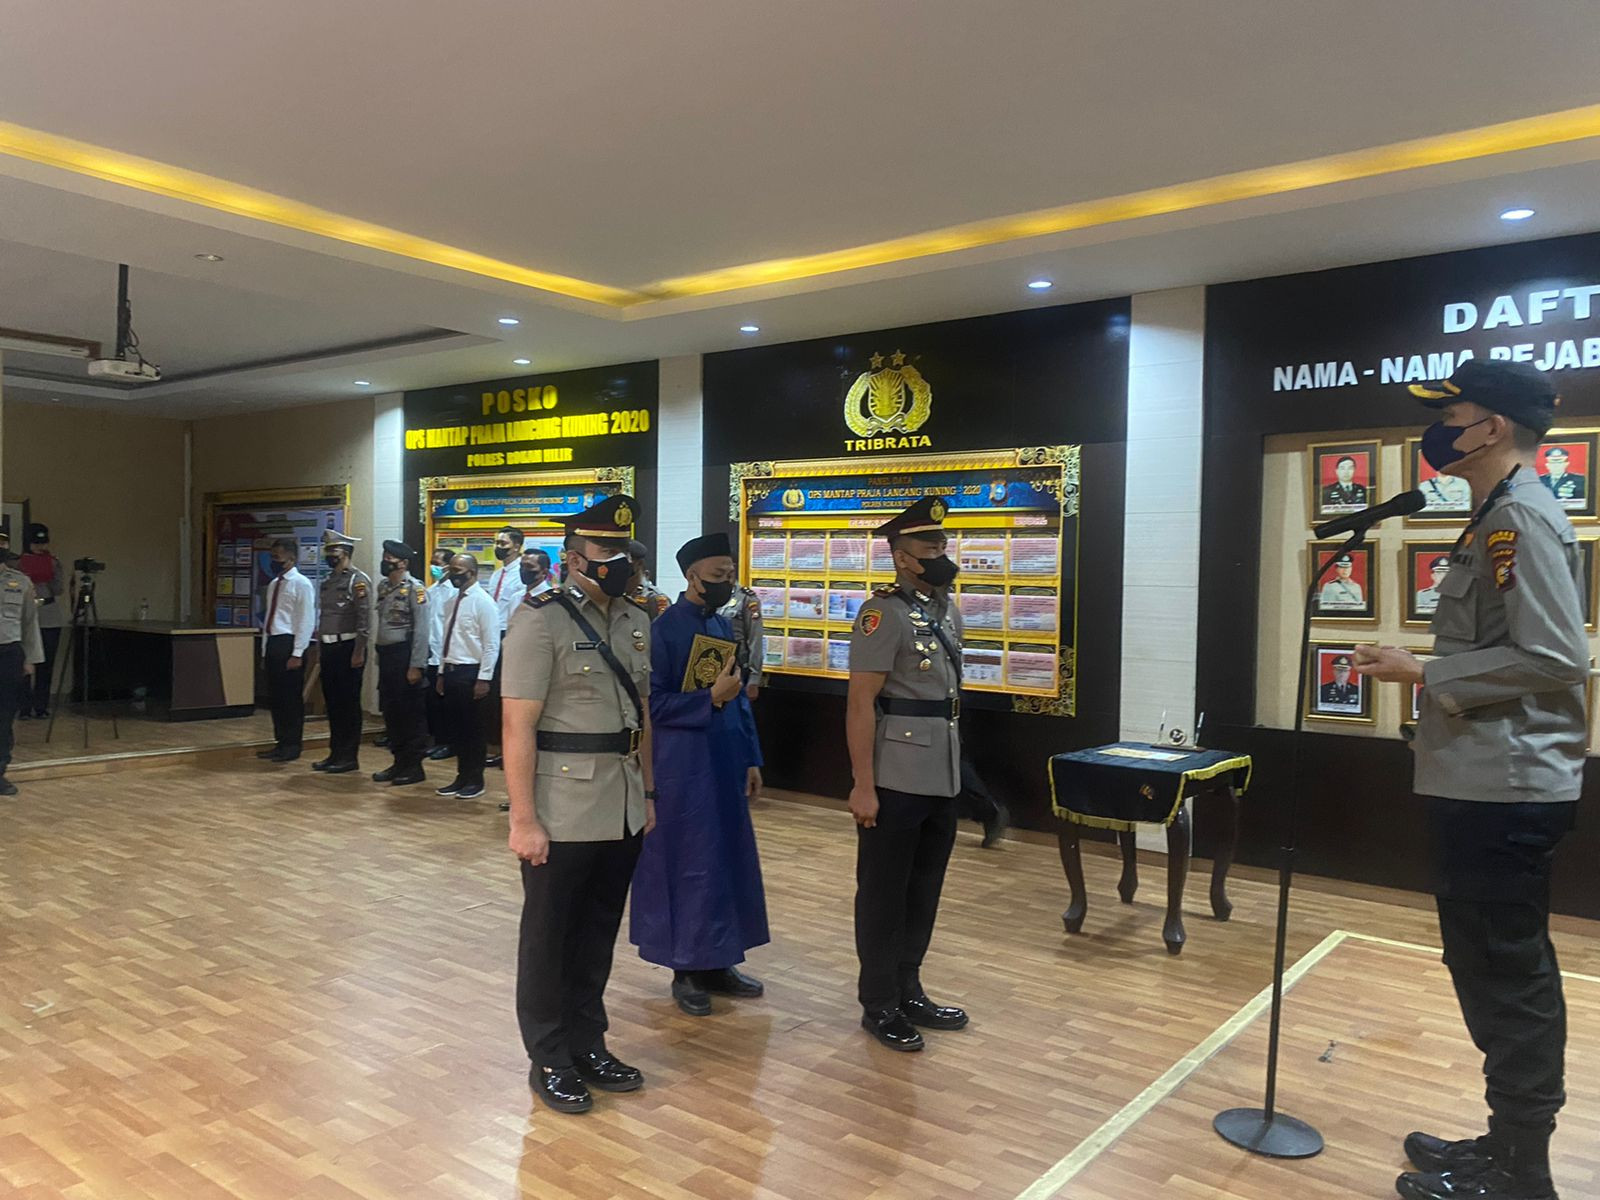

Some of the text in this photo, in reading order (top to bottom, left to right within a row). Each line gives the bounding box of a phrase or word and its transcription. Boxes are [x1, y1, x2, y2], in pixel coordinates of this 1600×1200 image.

[1443, 284, 1600, 334] DAFT
[1273, 361, 1359, 391] NAMA
[481, 385, 558, 415] POSKO
[405, 429, 426, 449] OPS
[561, 412, 609, 437] KUNING
[610, 409, 650, 434] 2020
[844, 435, 932, 452] TRIBRATA
[807, 485, 981, 499] OPS MANTAP PRAJA LANCANG KUNING 2020
